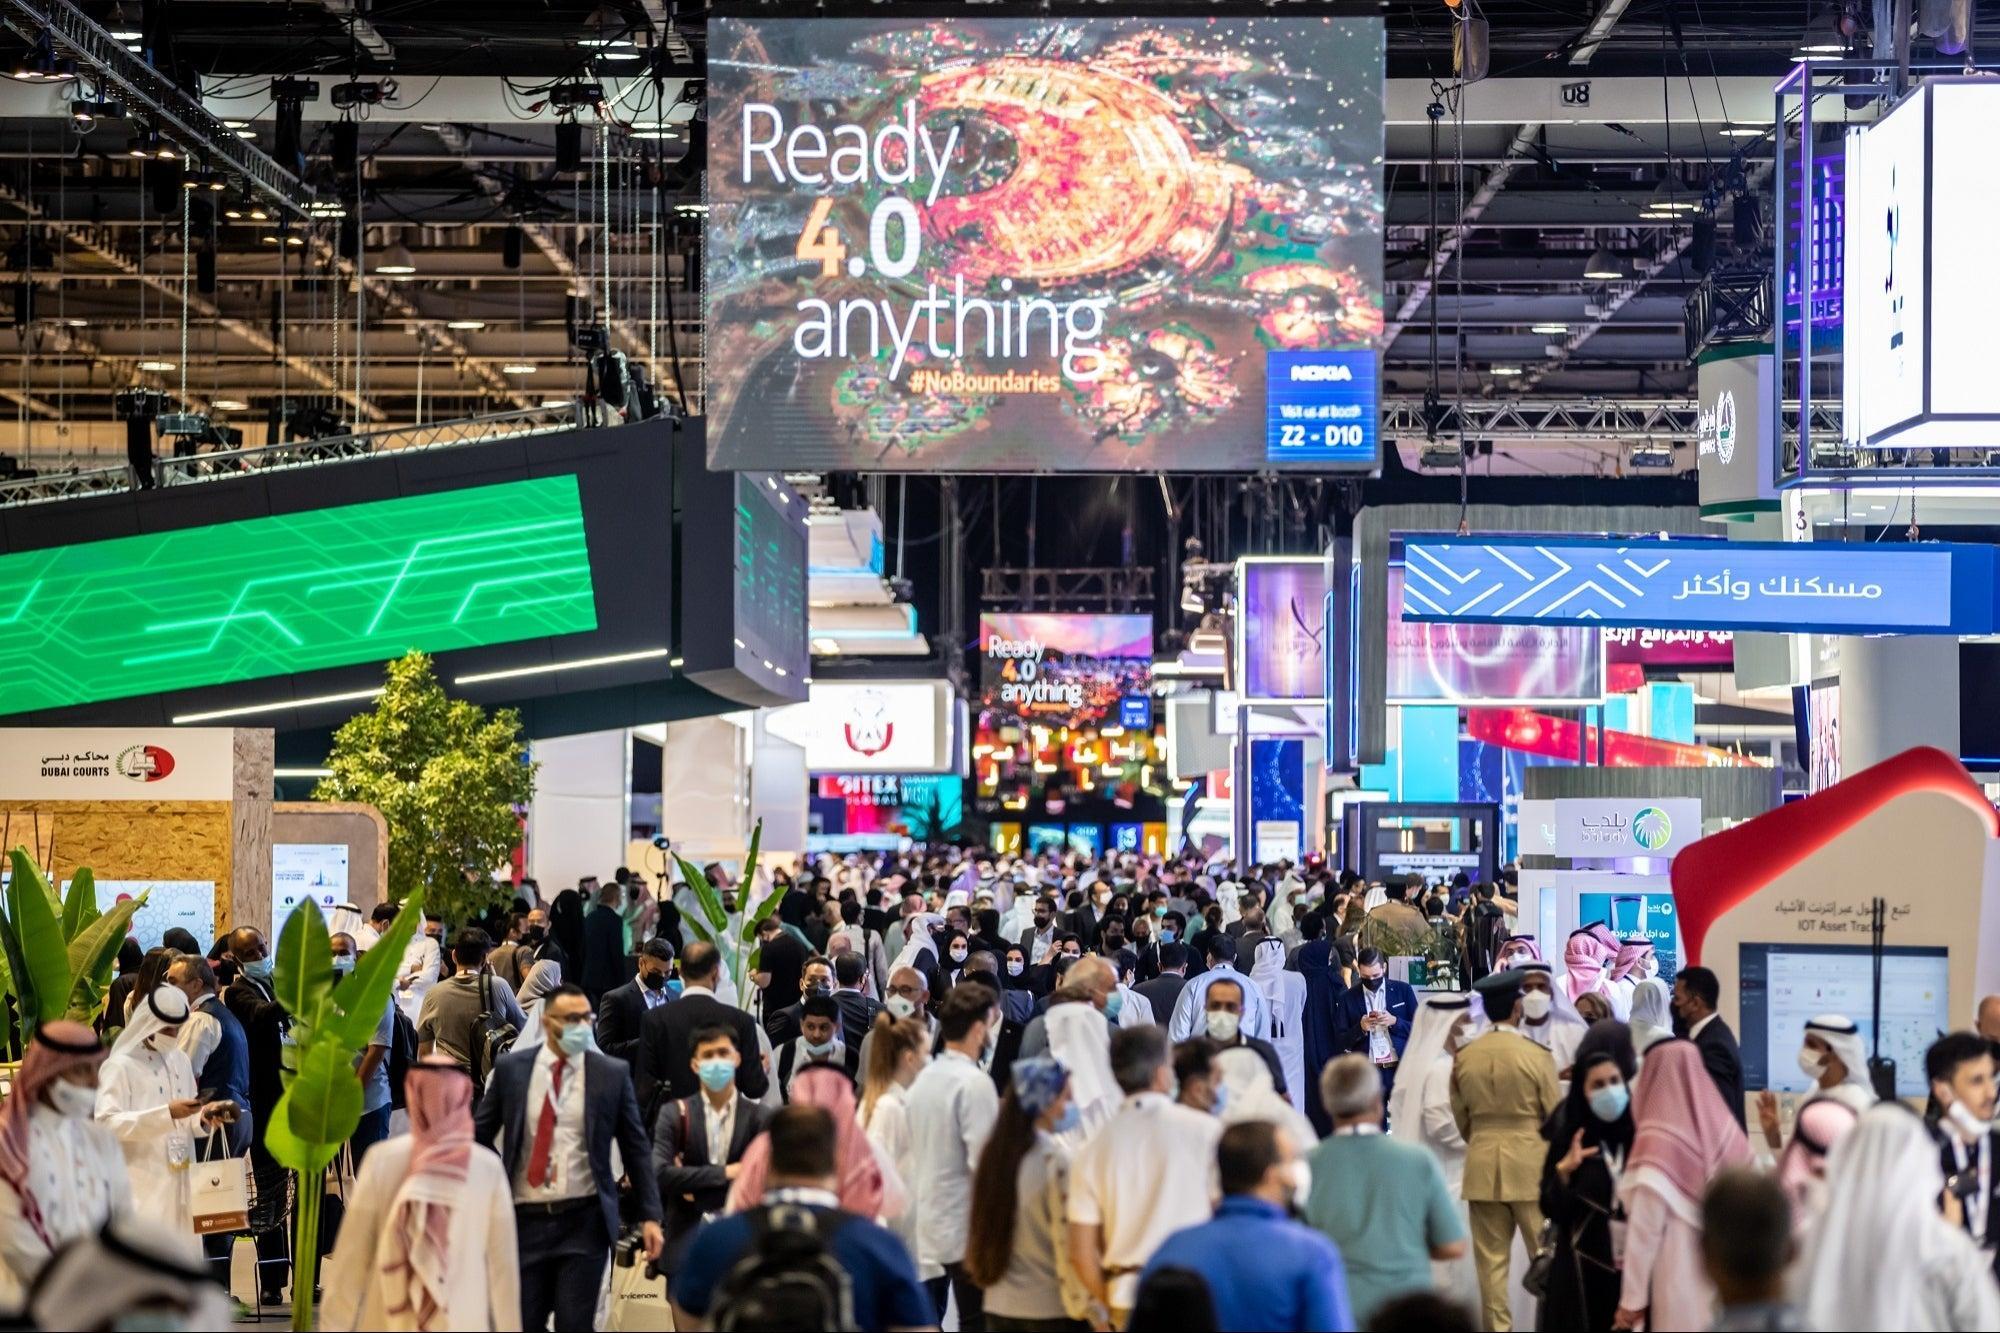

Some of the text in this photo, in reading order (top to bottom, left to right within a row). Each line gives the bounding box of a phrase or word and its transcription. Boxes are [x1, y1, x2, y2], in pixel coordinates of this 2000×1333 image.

[742, 98, 960, 207] Ready
[795, 196, 922, 278] 4.0
[793, 273, 1114, 383] anything
[909, 369, 1060, 394] #NoBoundaries
[1290, 364, 1353, 382] NOKIA
[1280, 424, 1305, 446] Z2
[1324, 424, 1363, 447] D10
[1672, 569, 1883, 600] مسكنك وأكثر
[988, 635, 1046, 663] Ready
[1001, 658, 1037, 682] 4.0
[1001, 678, 1083, 708] anything
[41, 751, 109, 765] محاكم دبي
[41, 767, 110, 777] DUBAI COURTS
[1582, 813, 1627, 832] بلدي
[1798, 919, 1816, 932] IOT
[1819, 919, 1848, 932] Asset
